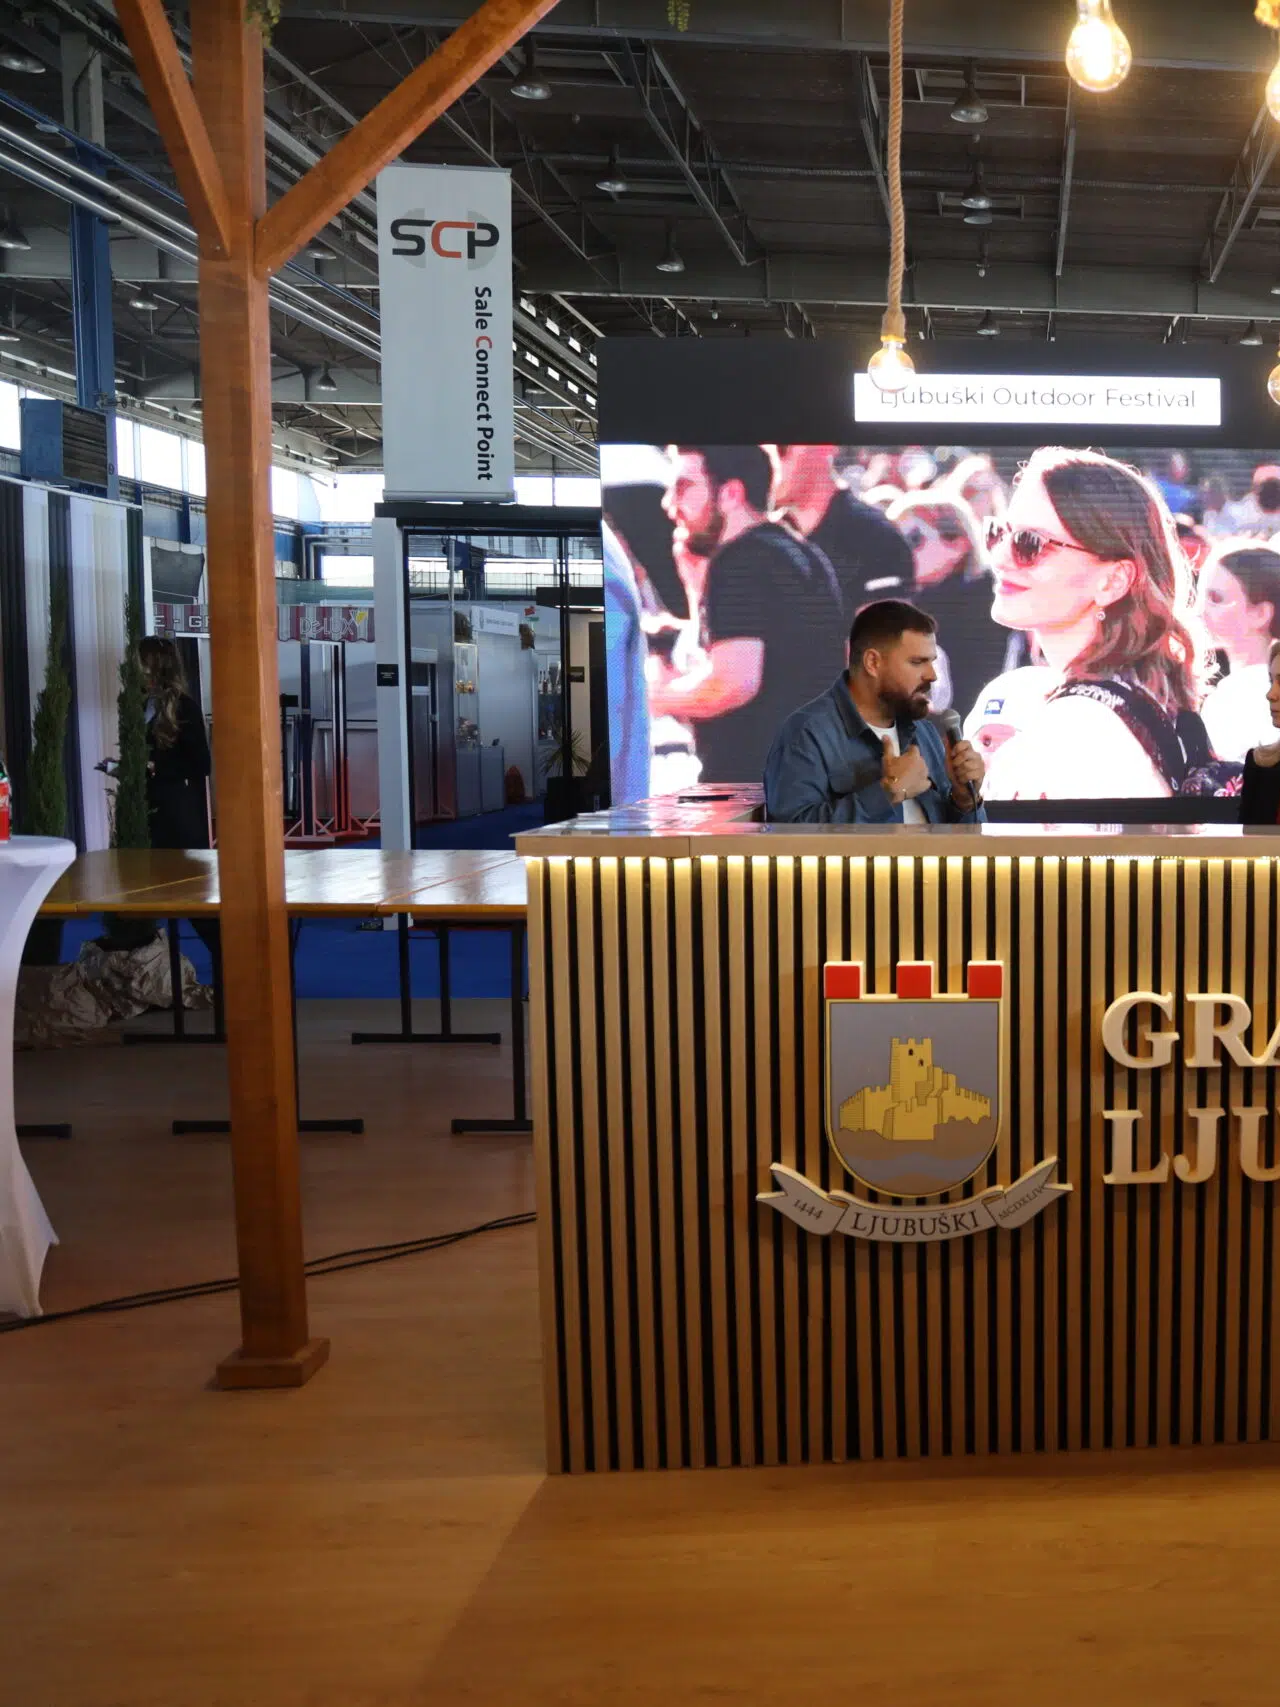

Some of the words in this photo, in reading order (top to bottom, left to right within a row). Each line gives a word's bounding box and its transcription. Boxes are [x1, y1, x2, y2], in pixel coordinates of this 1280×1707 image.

[390, 218, 499, 259] SCP
[475, 286, 493, 330] Sale
[476, 335, 493, 421] Connect
[993, 387, 1096, 407] Outdoor
[1106, 388, 1196, 408] Festival
[477, 427, 495, 481] Point
[793, 1198, 824, 1221] 1444
[850, 1209, 982, 1237] LJUBUŠKI
